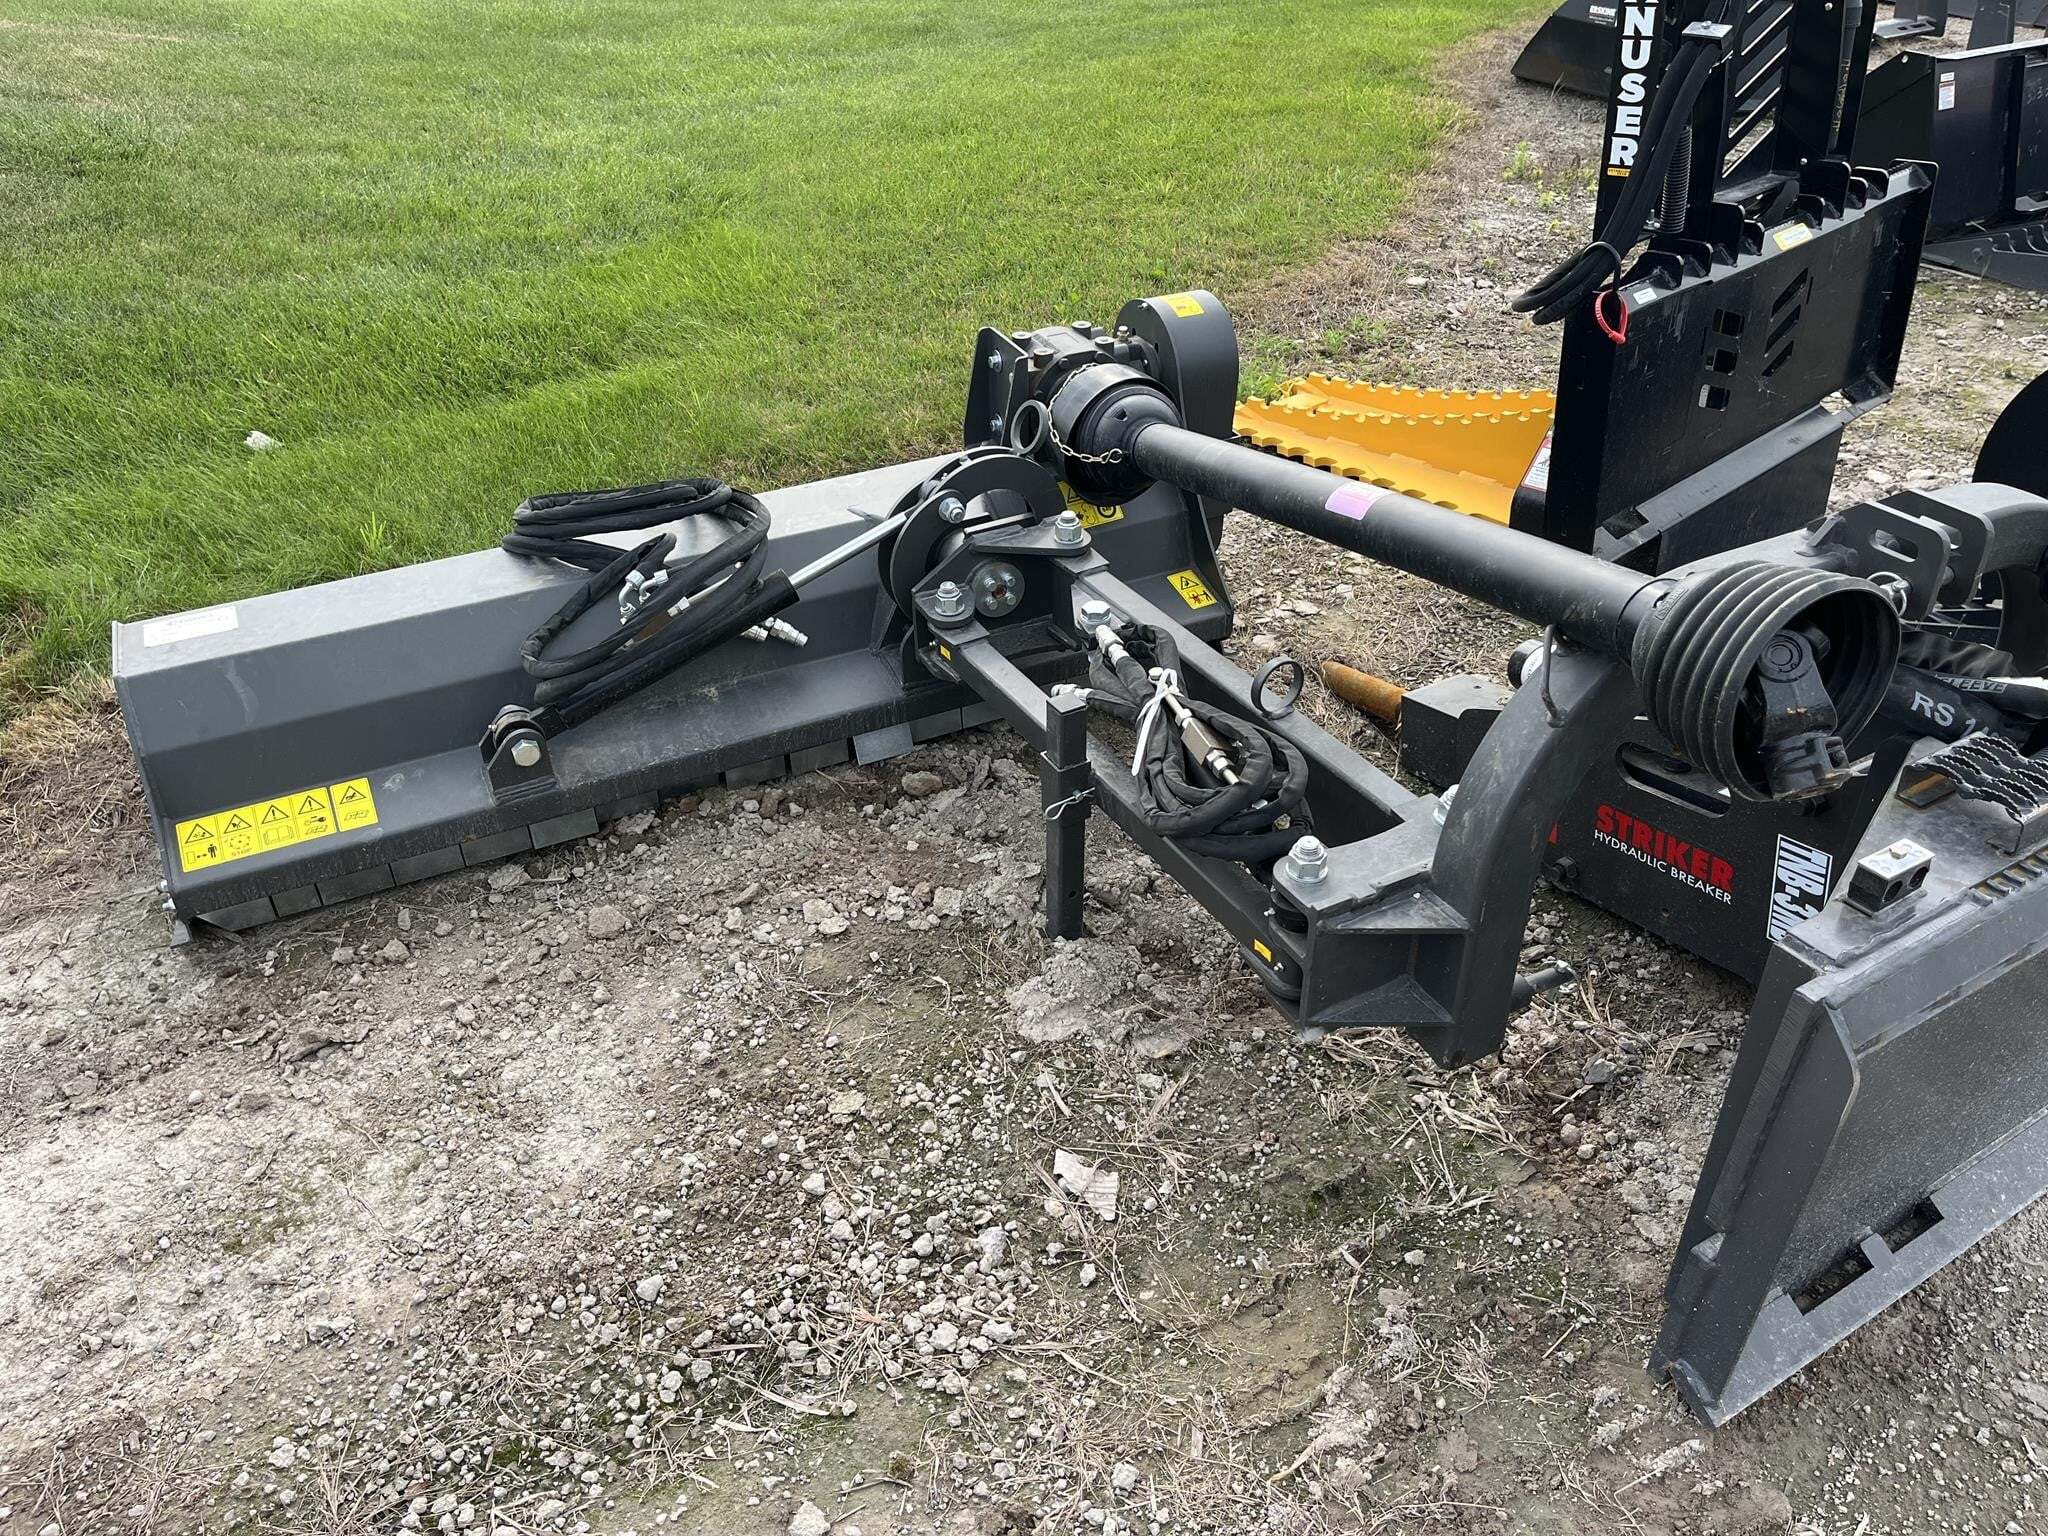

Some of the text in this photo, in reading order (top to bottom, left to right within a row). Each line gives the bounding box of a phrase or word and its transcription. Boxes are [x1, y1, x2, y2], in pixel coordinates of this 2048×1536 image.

[1608, 0, 1659, 166] NUSER
[1911, 690, 1955, 727] RS
[1594, 829, 1667, 873] HYDRAULIC
[1670, 866, 1732, 904] BREAKER
[1595, 804, 1736, 893] STRIKER
